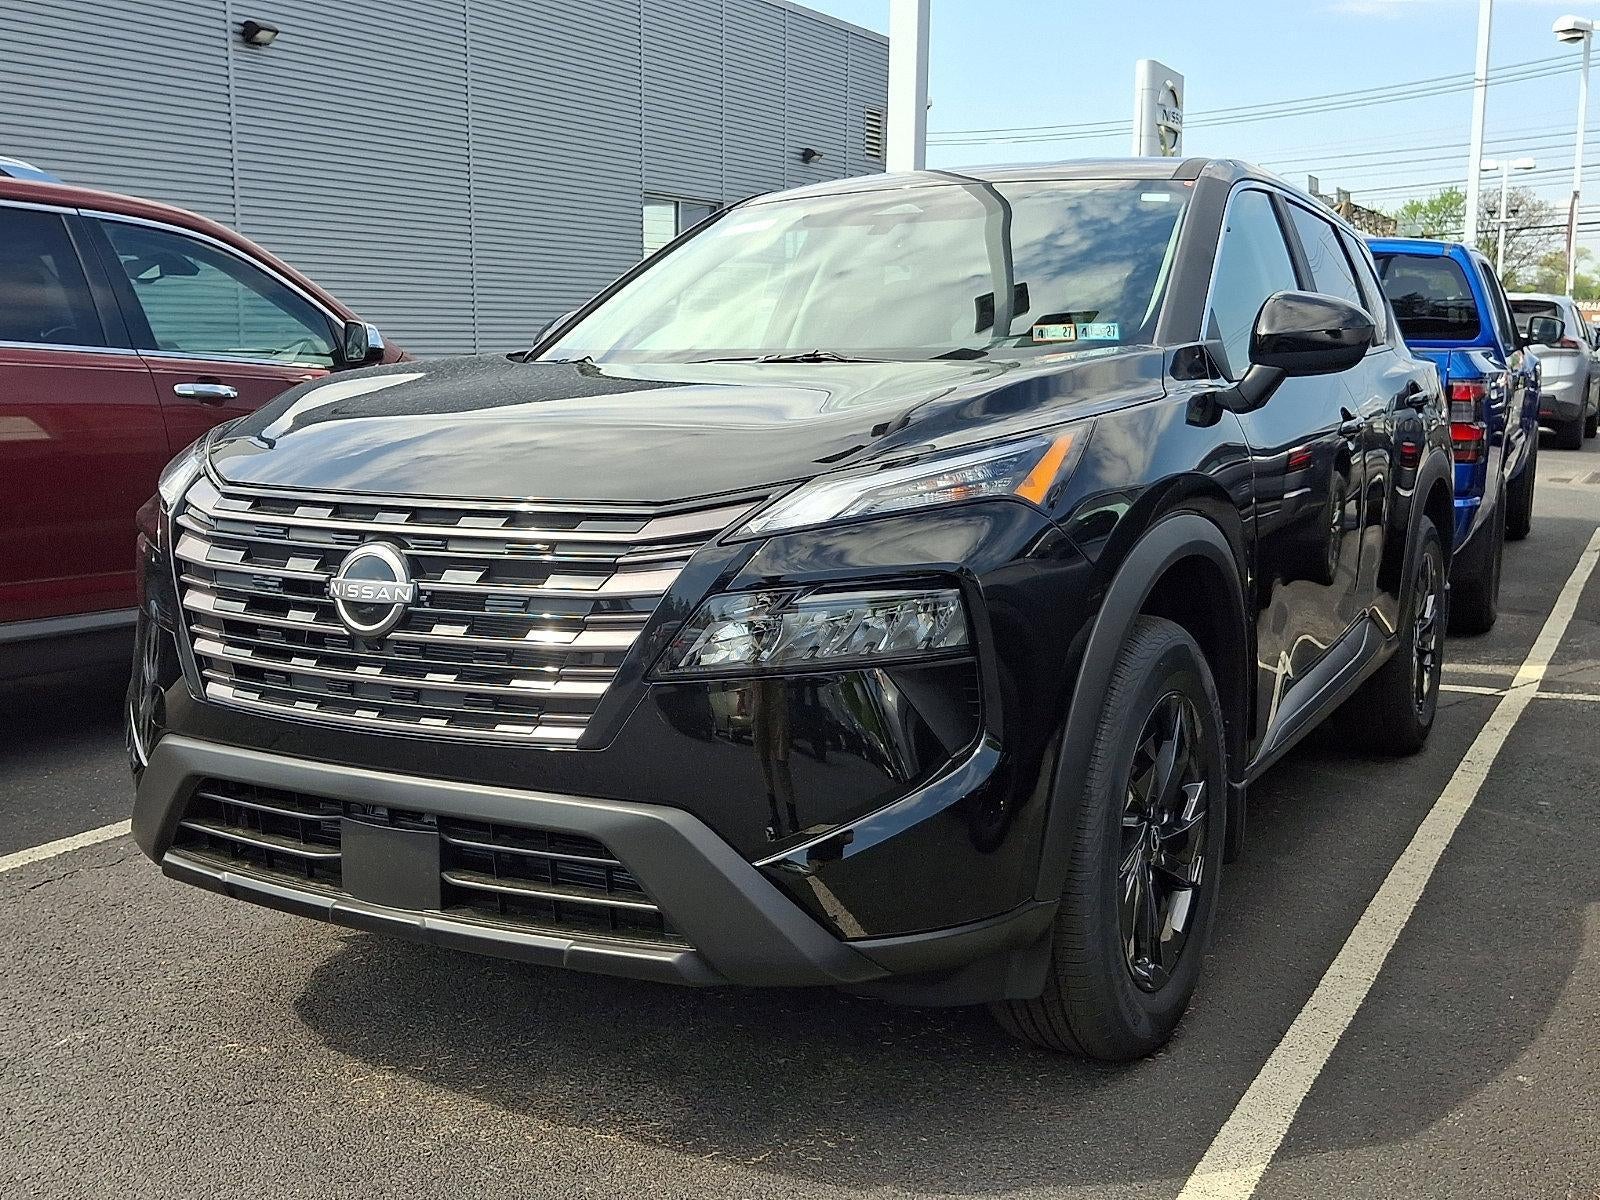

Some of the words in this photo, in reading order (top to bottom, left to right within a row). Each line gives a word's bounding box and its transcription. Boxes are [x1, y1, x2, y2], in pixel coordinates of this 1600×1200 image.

[1062, 326, 1072, 338] 27
[1106, 325, 1116, 337] 27
[329, 581, 411, 601] NISSAN
